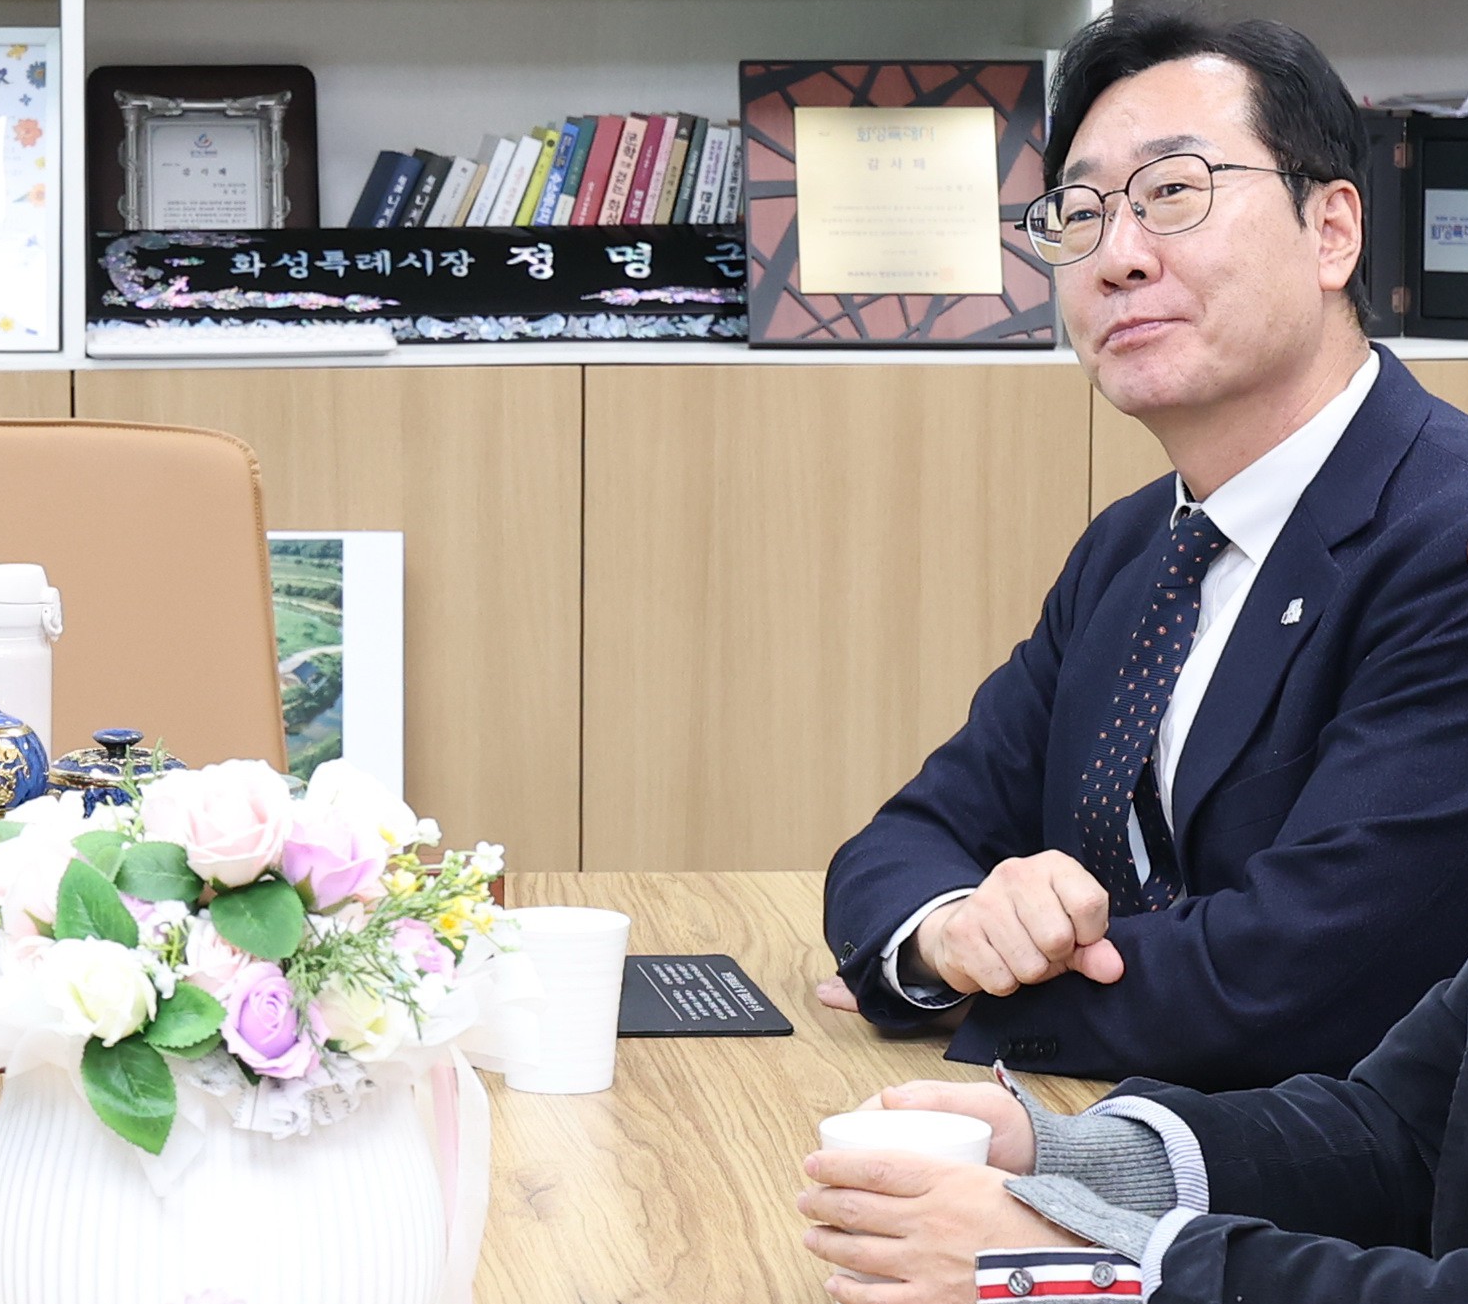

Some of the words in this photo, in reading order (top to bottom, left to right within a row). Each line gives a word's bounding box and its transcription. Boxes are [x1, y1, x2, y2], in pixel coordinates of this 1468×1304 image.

[228, 249, 475, 281] 화성특례시장
[506, 242, 556, 281] 정
[604, 240, 653, 280] 명
[705, 242, 746, 279] 근
